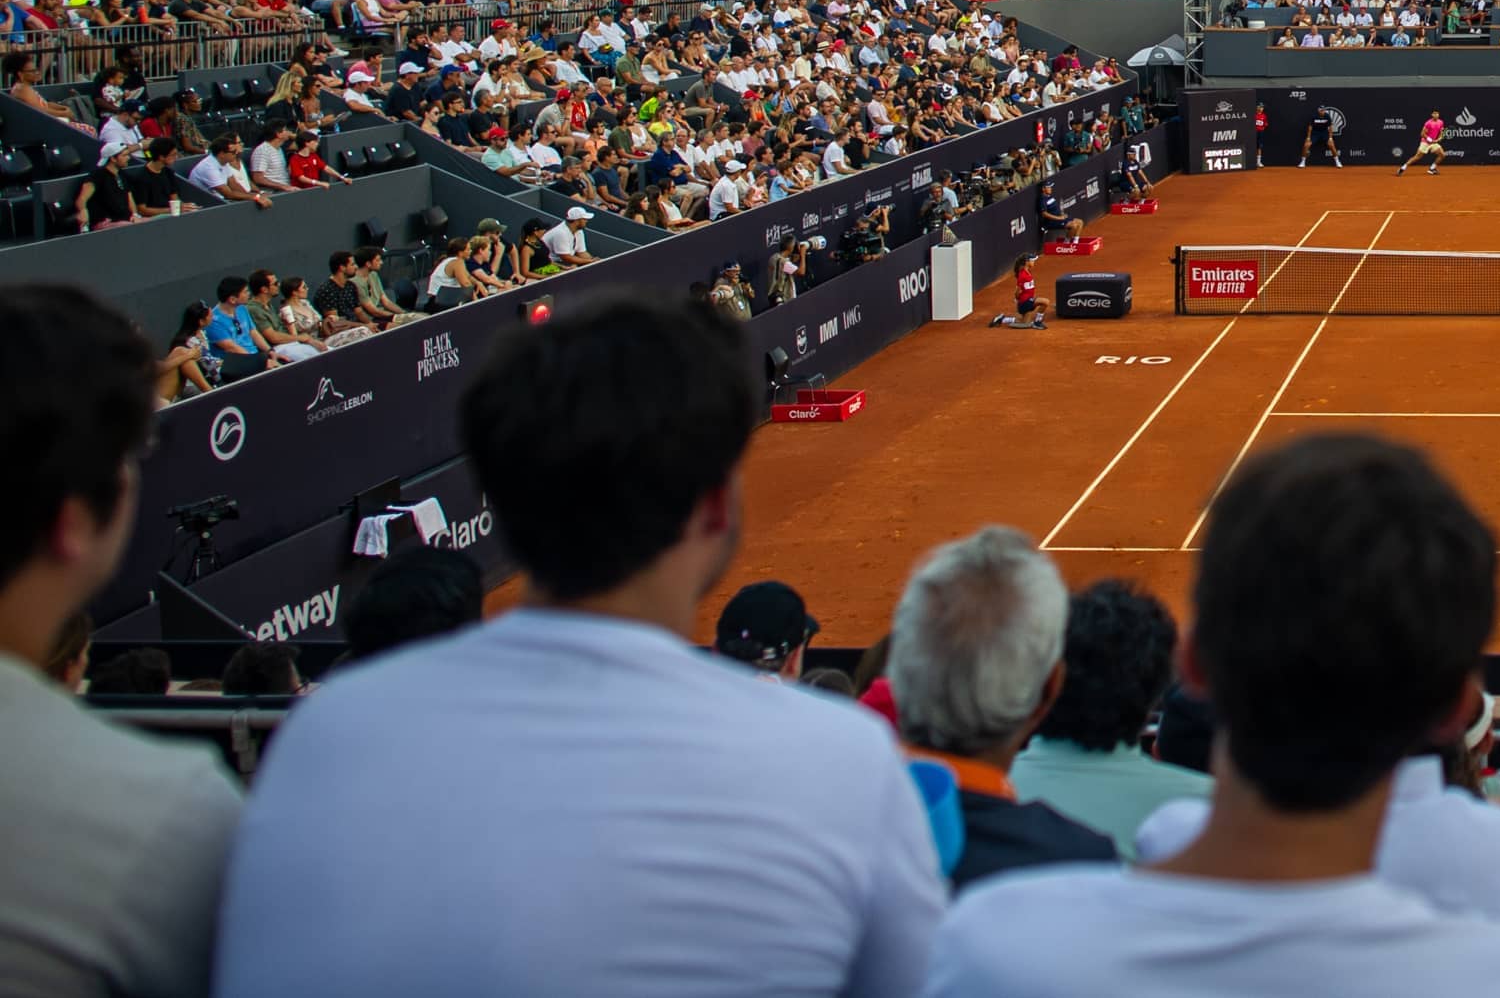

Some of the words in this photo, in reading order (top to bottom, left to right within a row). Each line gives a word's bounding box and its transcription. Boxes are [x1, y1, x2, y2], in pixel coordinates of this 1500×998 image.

[1201, 112, 1247, 122] MUBADALA
[1212, 130, 1237, 142] IMM
[1223, 149, 1242, 157] SPEED
[1206, 158, 1230, 170] 141
[1010, 216, 1026, 238] FILA
[1191, 267, 1255, 281] Emirates
[1201, 282, 1215, 294] FLY
[1216, 282, 1246, 294] BETTER
[819, 316, 838, 344] IMM
[423, 331, 453, 358] BLACK
[1094, 355, 1172, 365] RIO
[789, 409, 816, 419] Claro
[240, 584, 340, 642] etway
